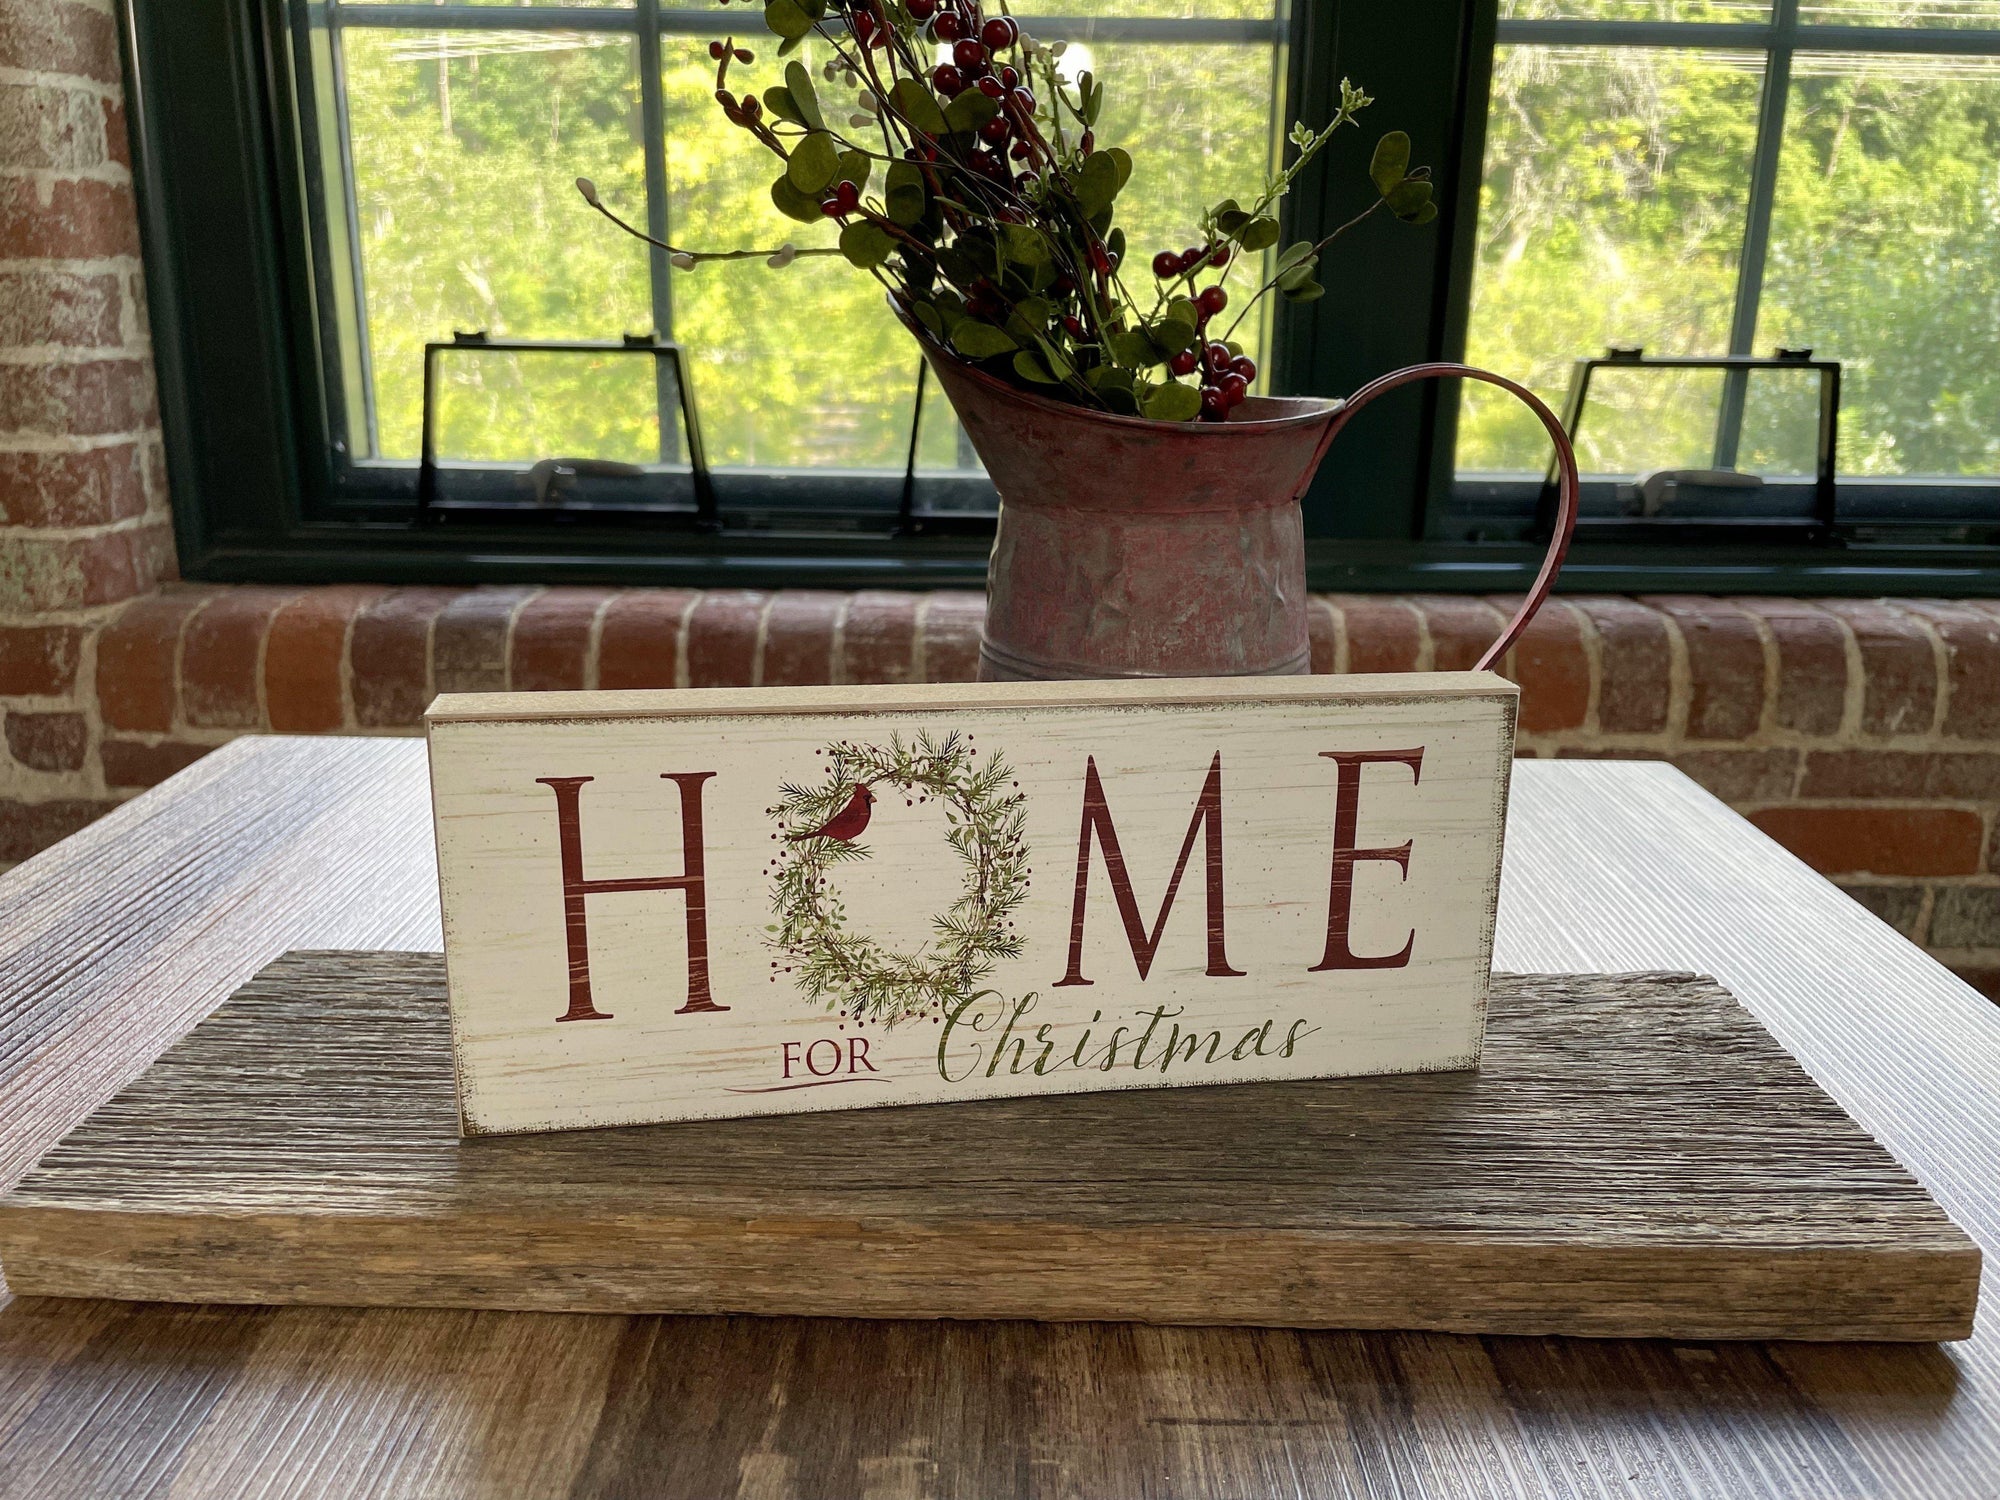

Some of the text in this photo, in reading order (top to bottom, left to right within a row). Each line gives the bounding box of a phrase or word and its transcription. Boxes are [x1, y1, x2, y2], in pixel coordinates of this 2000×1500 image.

[535, 732, 1424, 1025] HOME
[781, 989, 1321, 1083] FOR Christmas
